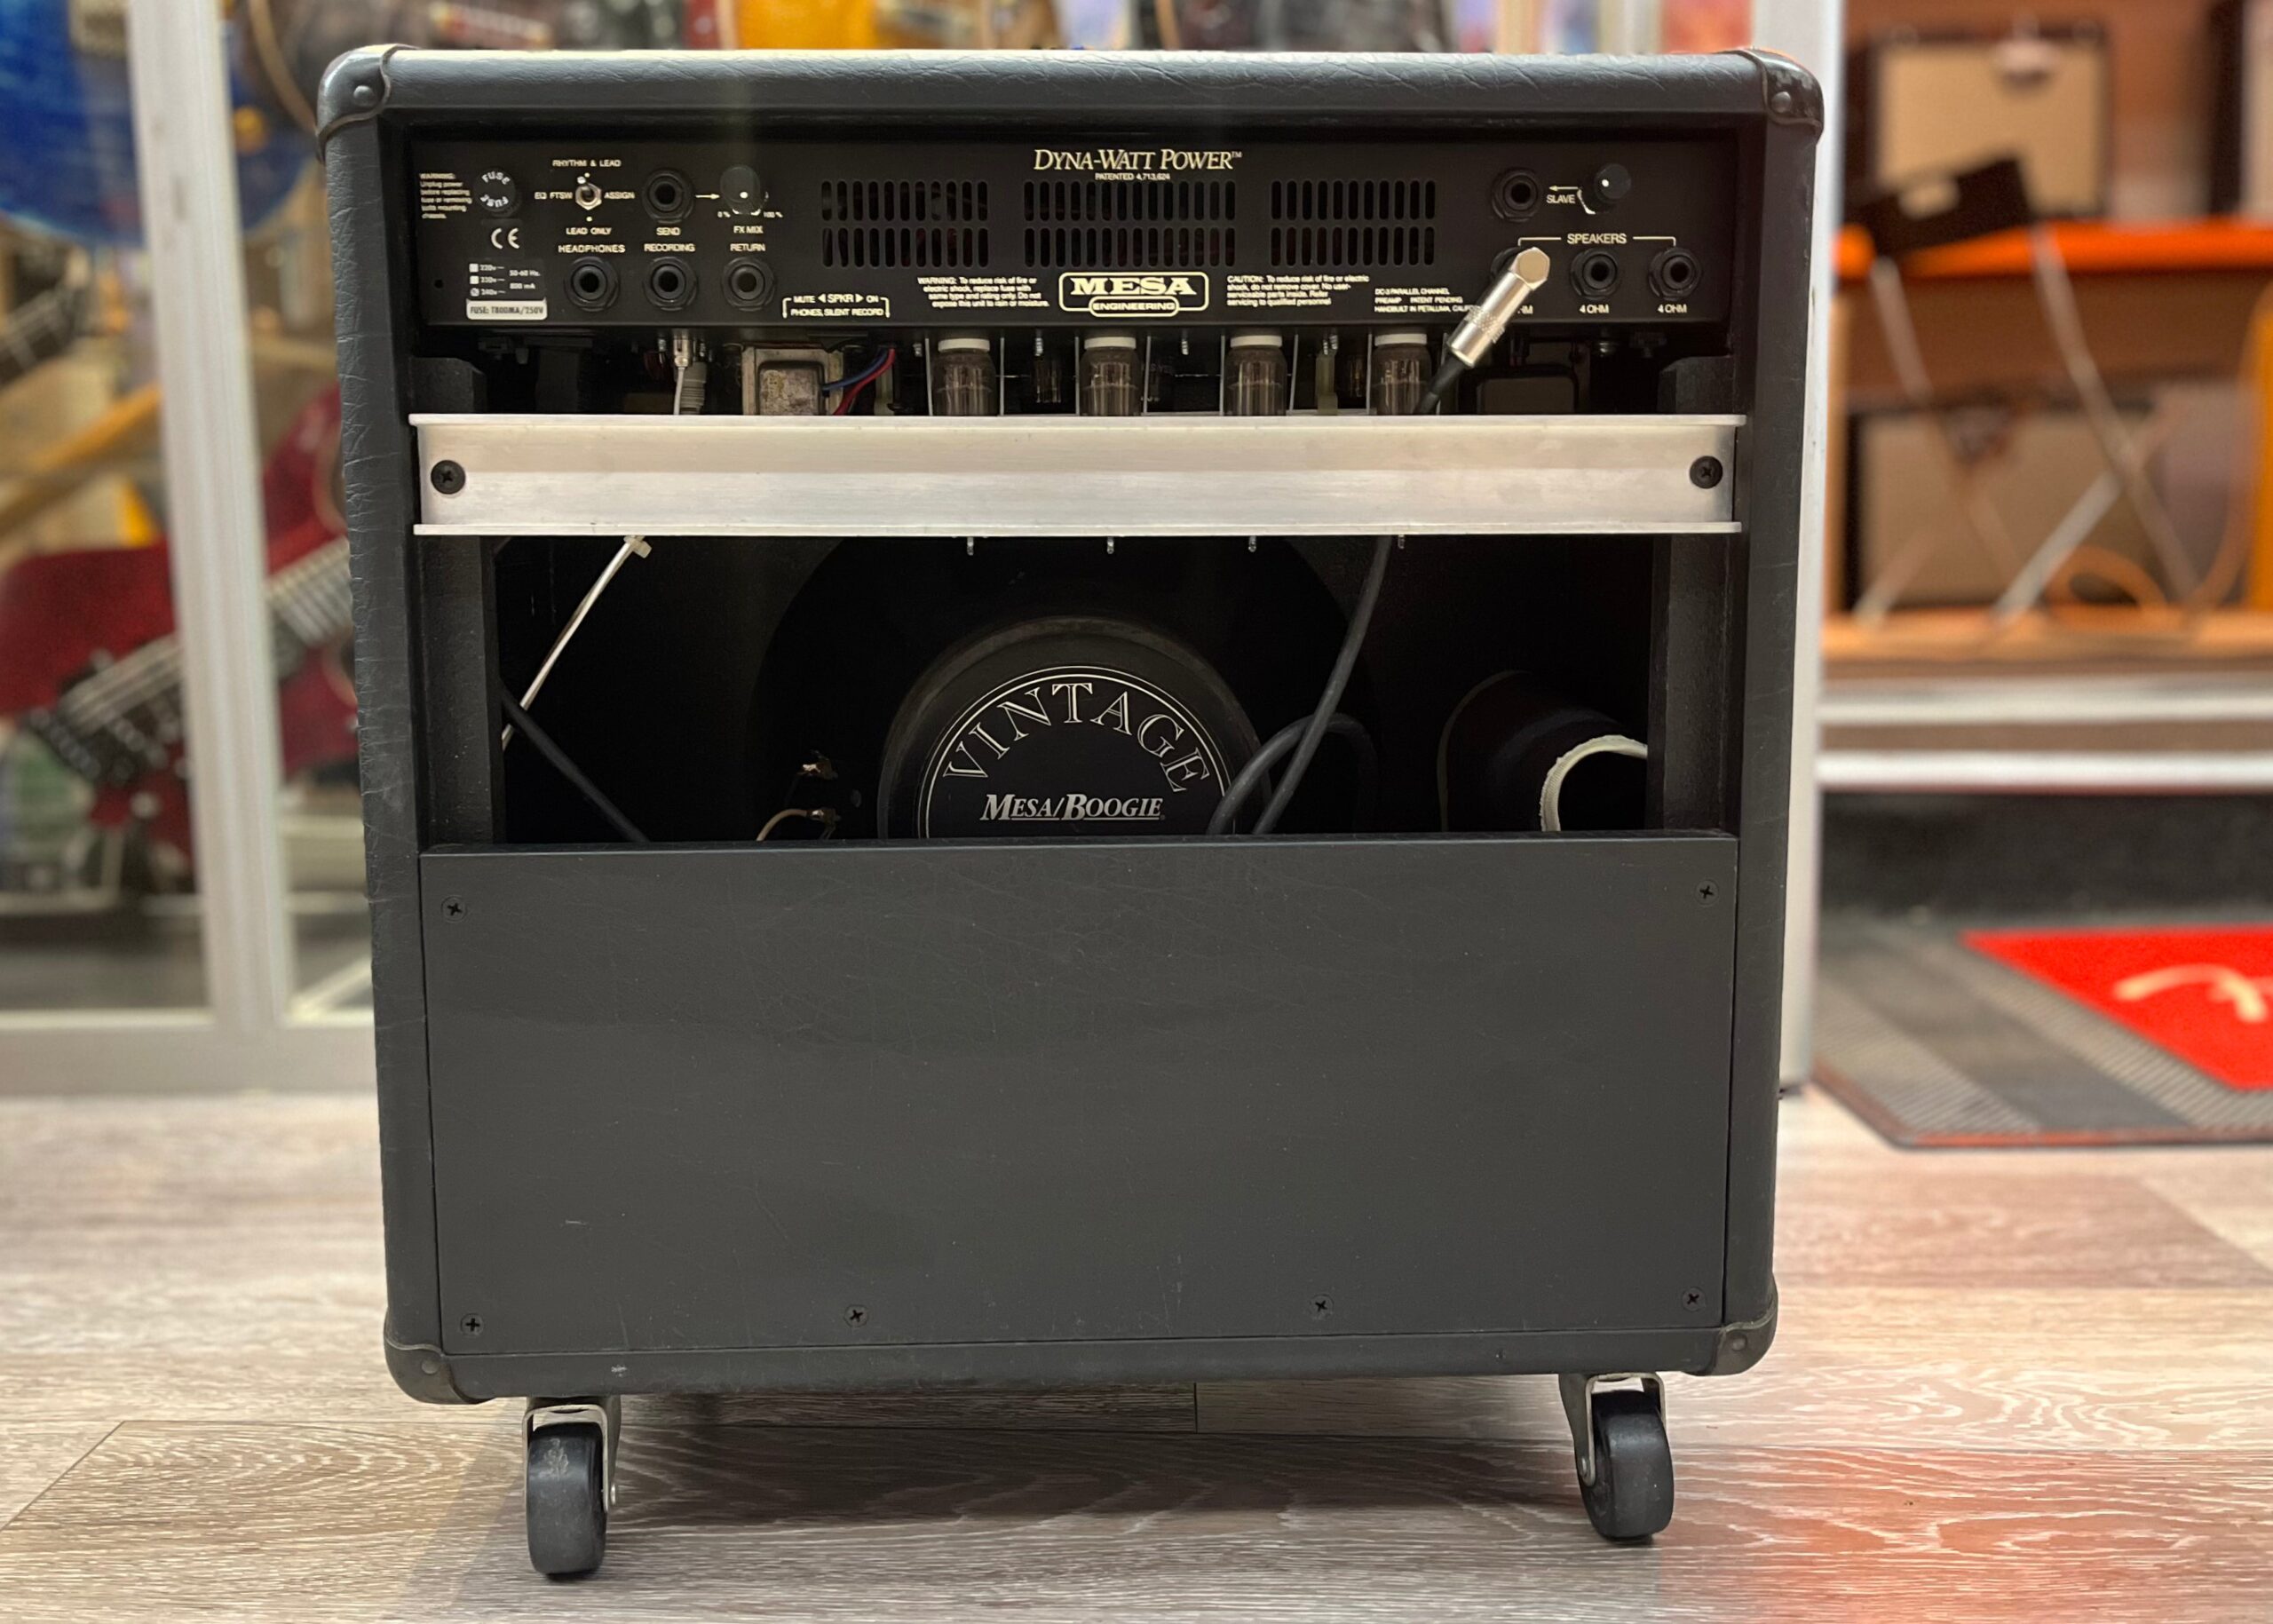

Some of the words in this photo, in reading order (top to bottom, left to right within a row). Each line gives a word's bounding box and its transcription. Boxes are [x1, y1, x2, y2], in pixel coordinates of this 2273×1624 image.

[481, 171, 511, 185] FUSE
[480, 194, 509, 208] FUSE
[1546, 194, 1576, 204] SLAVE
[566, 226, 588, 235] LEAD
[590, 226, 612, 235] ONLY
[656, 226, 681, 235] SEND
[491, 227, 520, 250] CE
[1566, 233, 1628, 244] SPEAKERS
[558, 244, 626, 253] HEADPHONES
[644, 243, 695, 252] RECORDING
[730, 243, 766, 252] RETURN
[1070, 277, 1197, 295] MESA
[793, 295, 816, 304] MUTE
[828, 295, 853, 304] SPKR
[866, 295, 879, 304] ON
[1227, 298, 1258, 307] servicing
[1259, 298, 1266, 307] to
[1267, 298, 1296, 307] qualified
[824, 308, 851, 317] SILENT
[851, 308, 884, 317] RECORD
[1580, 304, 1586, 313] 4
[1587, 304, 1610, 313] OHM
[1657, 304, 1664, 313] 4
[1665, 304, 1687, 313] OHM
[942, 683, 1210, 792] VINTAGE
